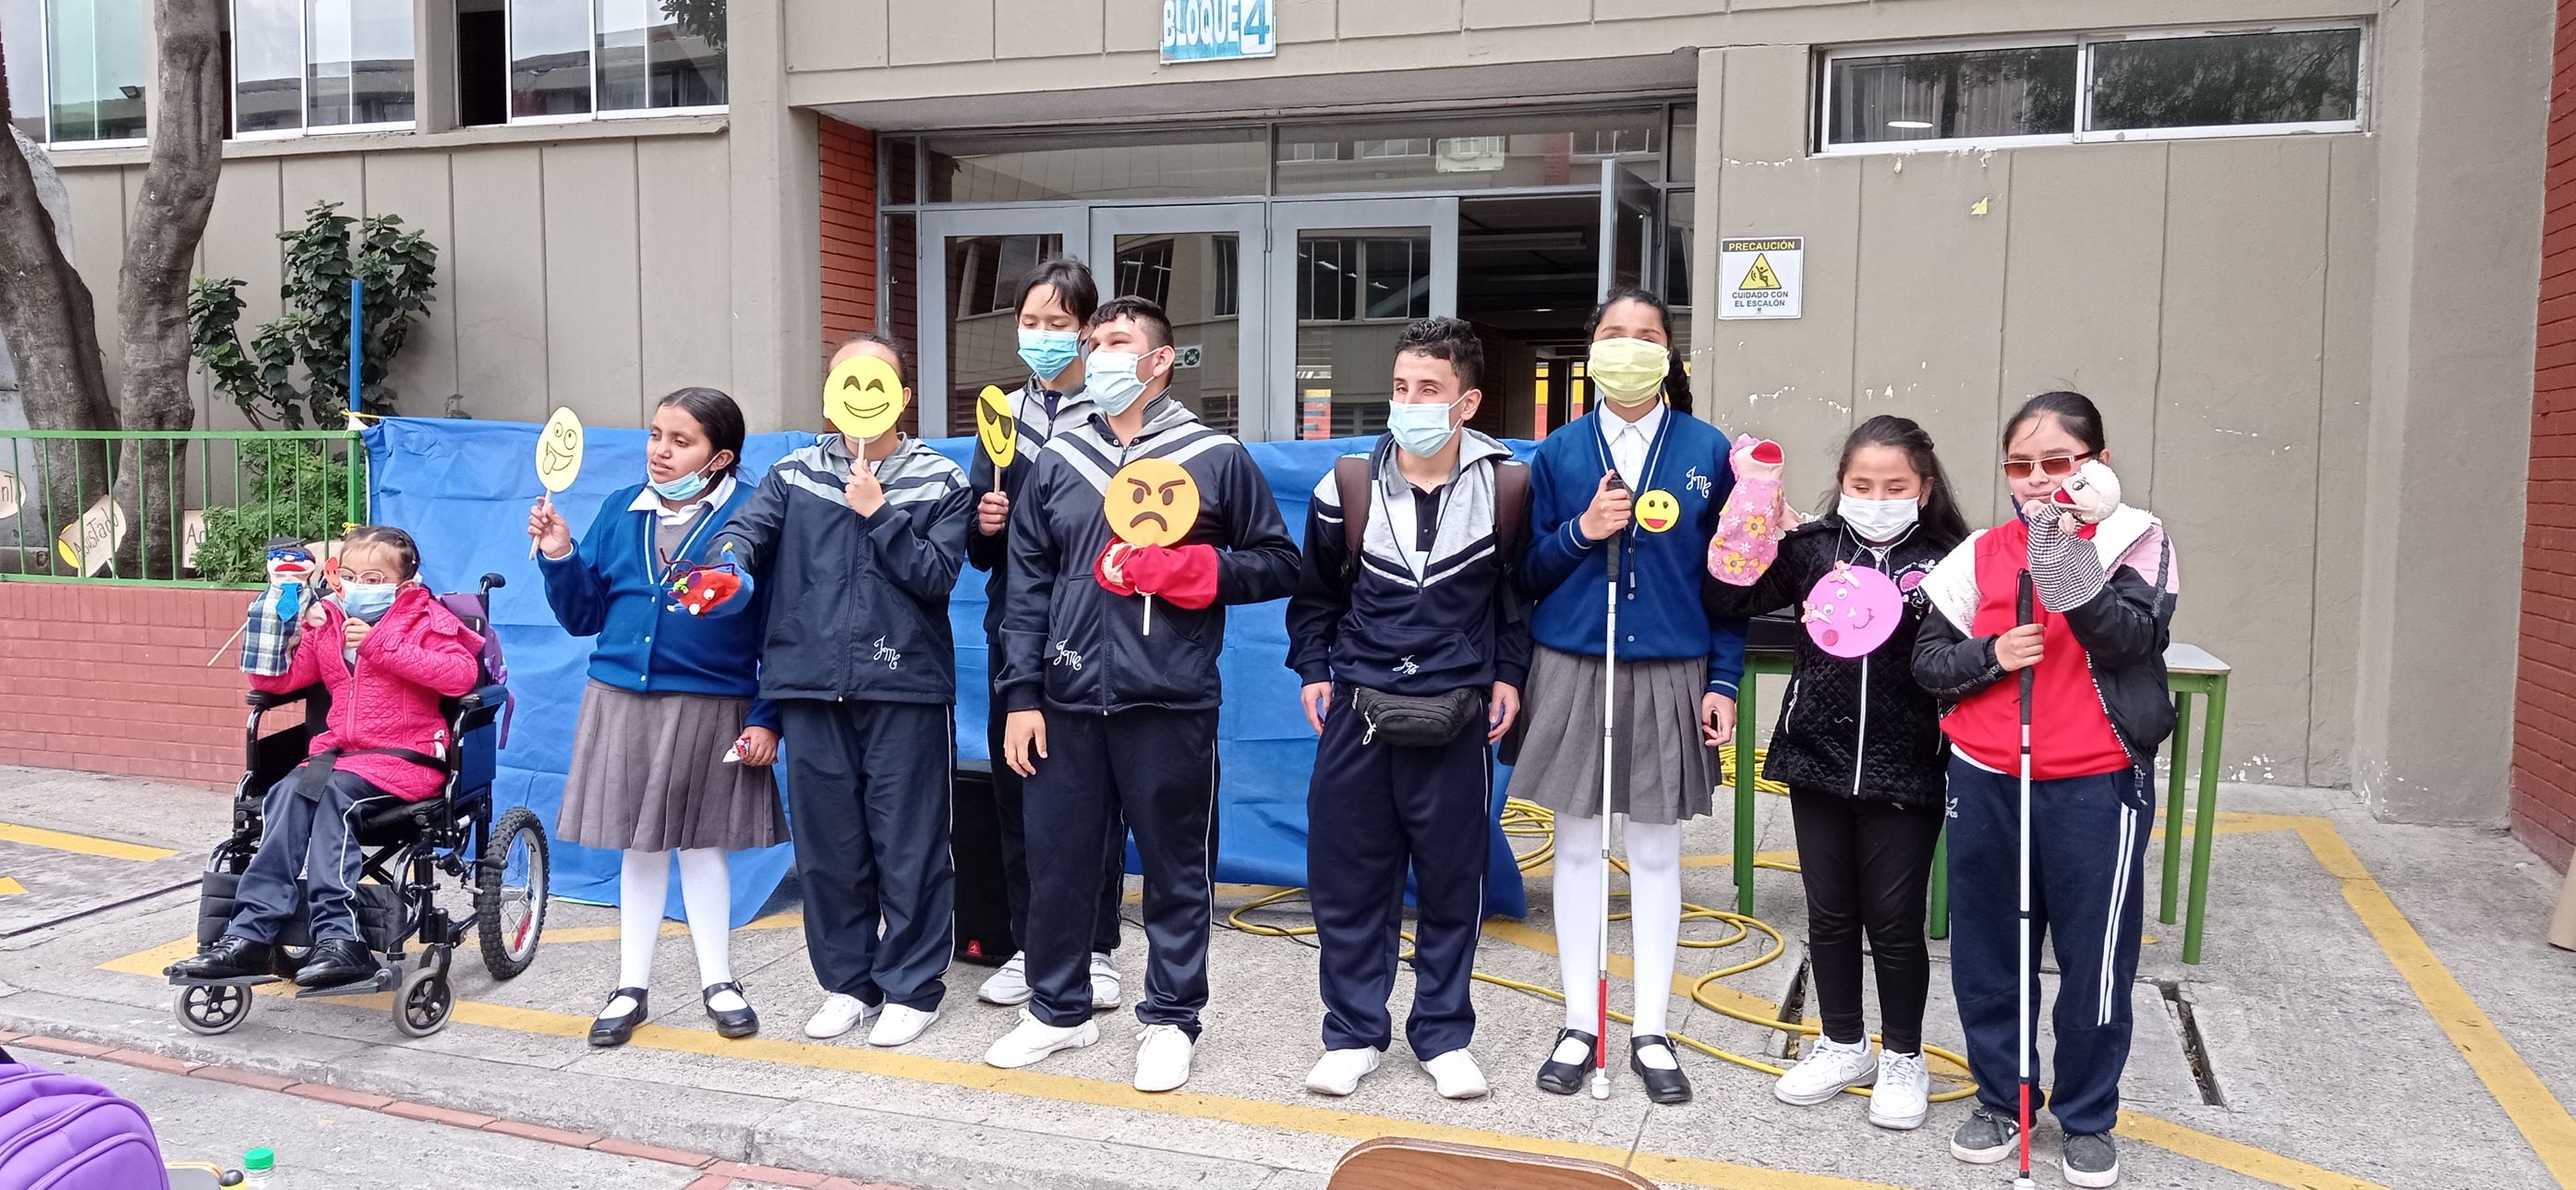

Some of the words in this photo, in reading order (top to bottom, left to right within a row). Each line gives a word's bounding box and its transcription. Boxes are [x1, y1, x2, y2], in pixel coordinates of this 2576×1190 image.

[1164, 0, 1239, 47] BLOQUE
[1244, 0, 1270, 44] 4
[1728, 240, 1796, 251] PRECAUCIÓN
[1747, 298, 1785, 308] ESCALÓN
